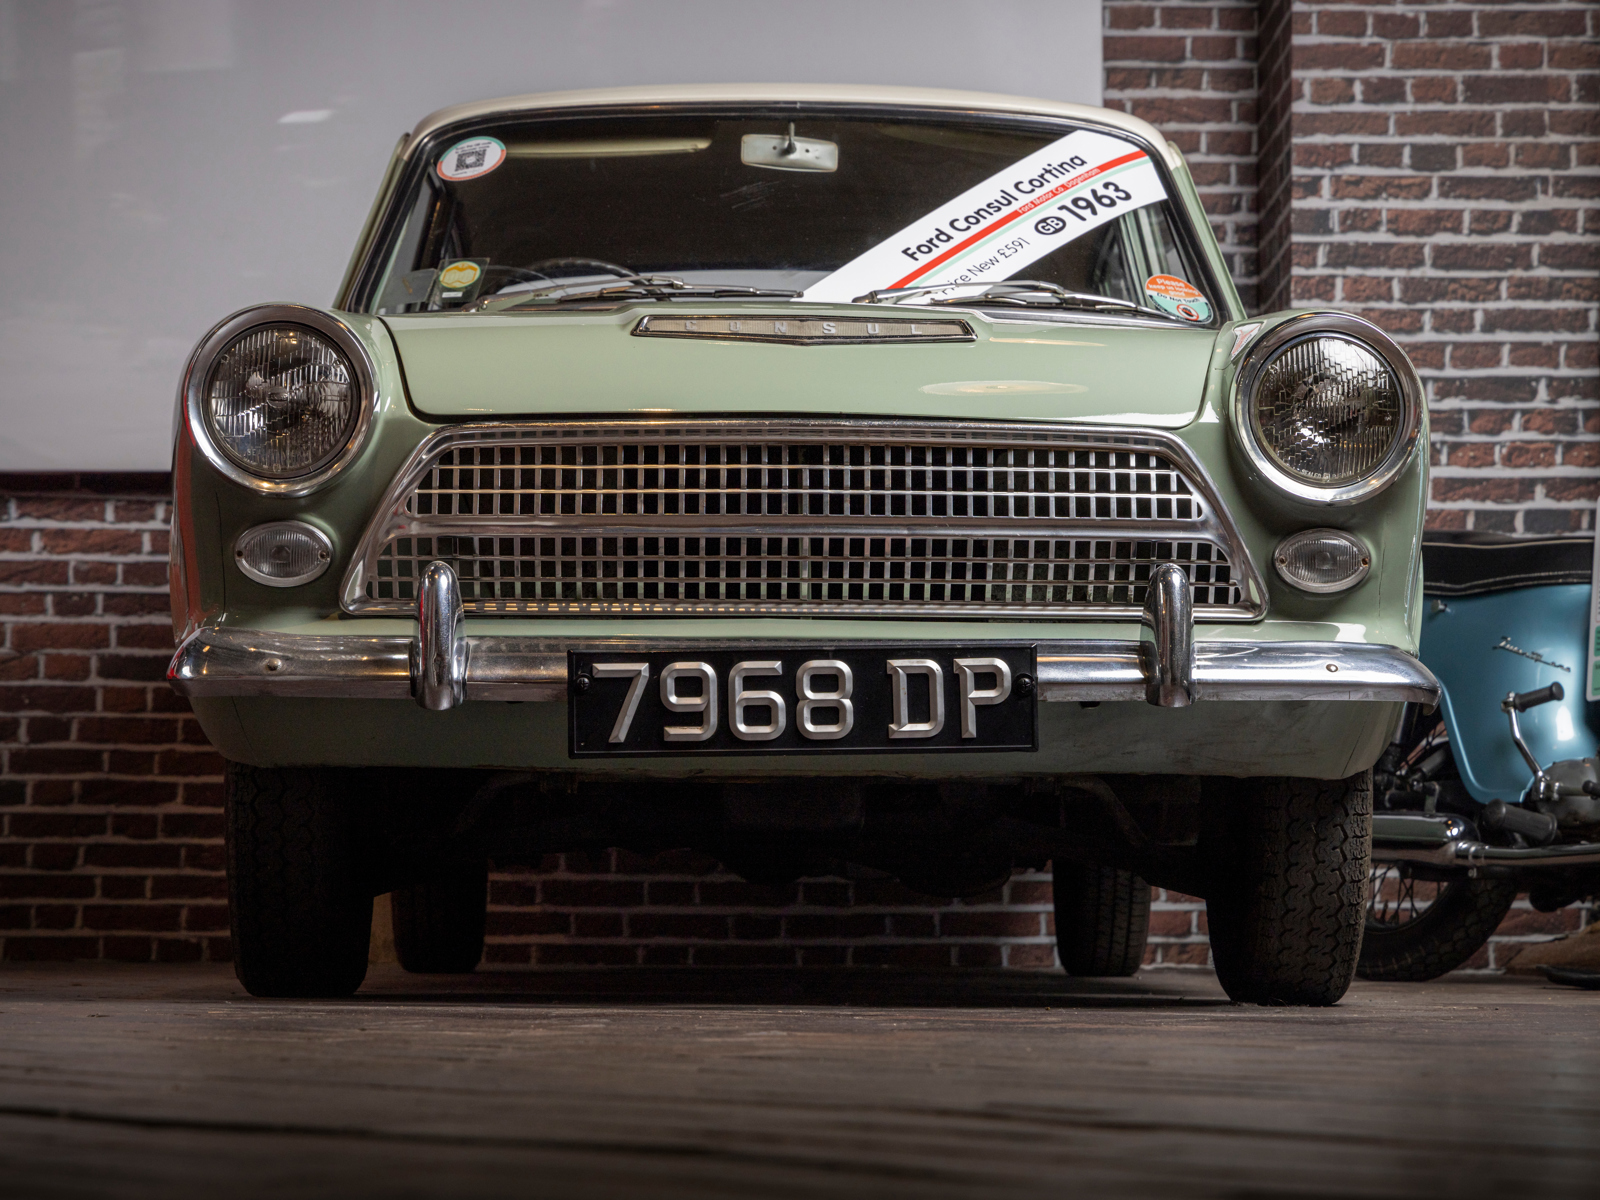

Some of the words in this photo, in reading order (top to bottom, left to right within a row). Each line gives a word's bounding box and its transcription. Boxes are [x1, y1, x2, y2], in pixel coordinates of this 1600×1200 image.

[901, 227, 954, 262] Ford
[949, 189, 1017, 233] Consul
[1013, 155, 1088, 195] Cortina
[1016, 201, 1034, 214] Ford
[1032, 190, 1054, 205] Motor
[1052, 184, 1067, 195] Co.
[1064, 167, 1101, 187] Dagenham
[1057, 181, 1132, 222] 1963
[1038, 216, 1064, 234] GB
[941, 274, 972, 295] ice
[966, 255, 1000, 277] New
[997, 236, 1031, 259] £591
[1156, 277, 1185, 288] Please
[685, 320, 923, 335] CONSUL
[592, 658, 855, 744] 7968
[886, 657, 1012, 739] DP
